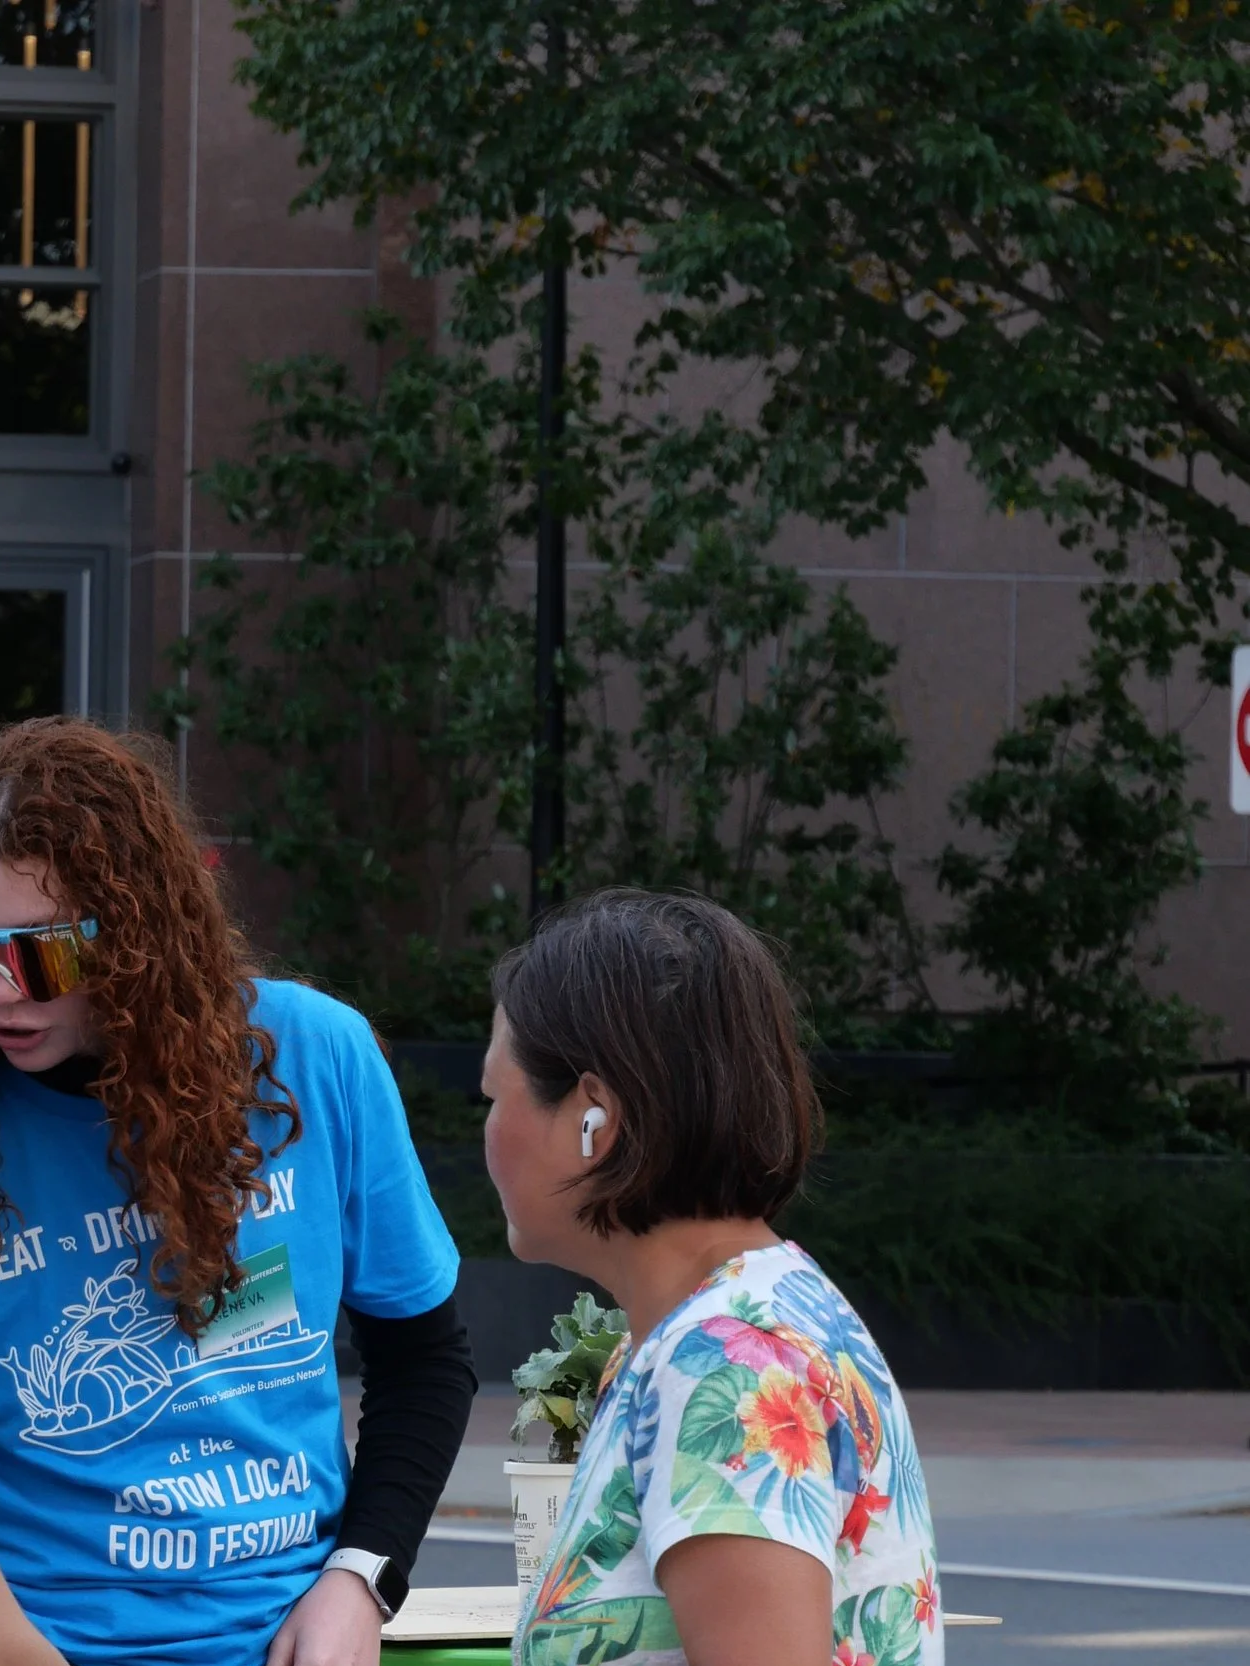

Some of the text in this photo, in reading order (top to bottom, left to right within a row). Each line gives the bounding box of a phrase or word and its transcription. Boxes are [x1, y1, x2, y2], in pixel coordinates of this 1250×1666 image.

[84, 1202, 168, 1254] DRIN
[234, 1168, 296, 1223] LAY
[231, 1320, 265, 1339] VOLUNTEER
[172, 1400, 199, 1414] From
[199, 1394, 218, 1407] The
[257, 1375, 295, 1391] Business
[170, 1437, 235, 1465] at the
[225, 1451, 312, 1505] LOCAL
[109, 1510, 318, 1571] FOOD FESTIVAL
